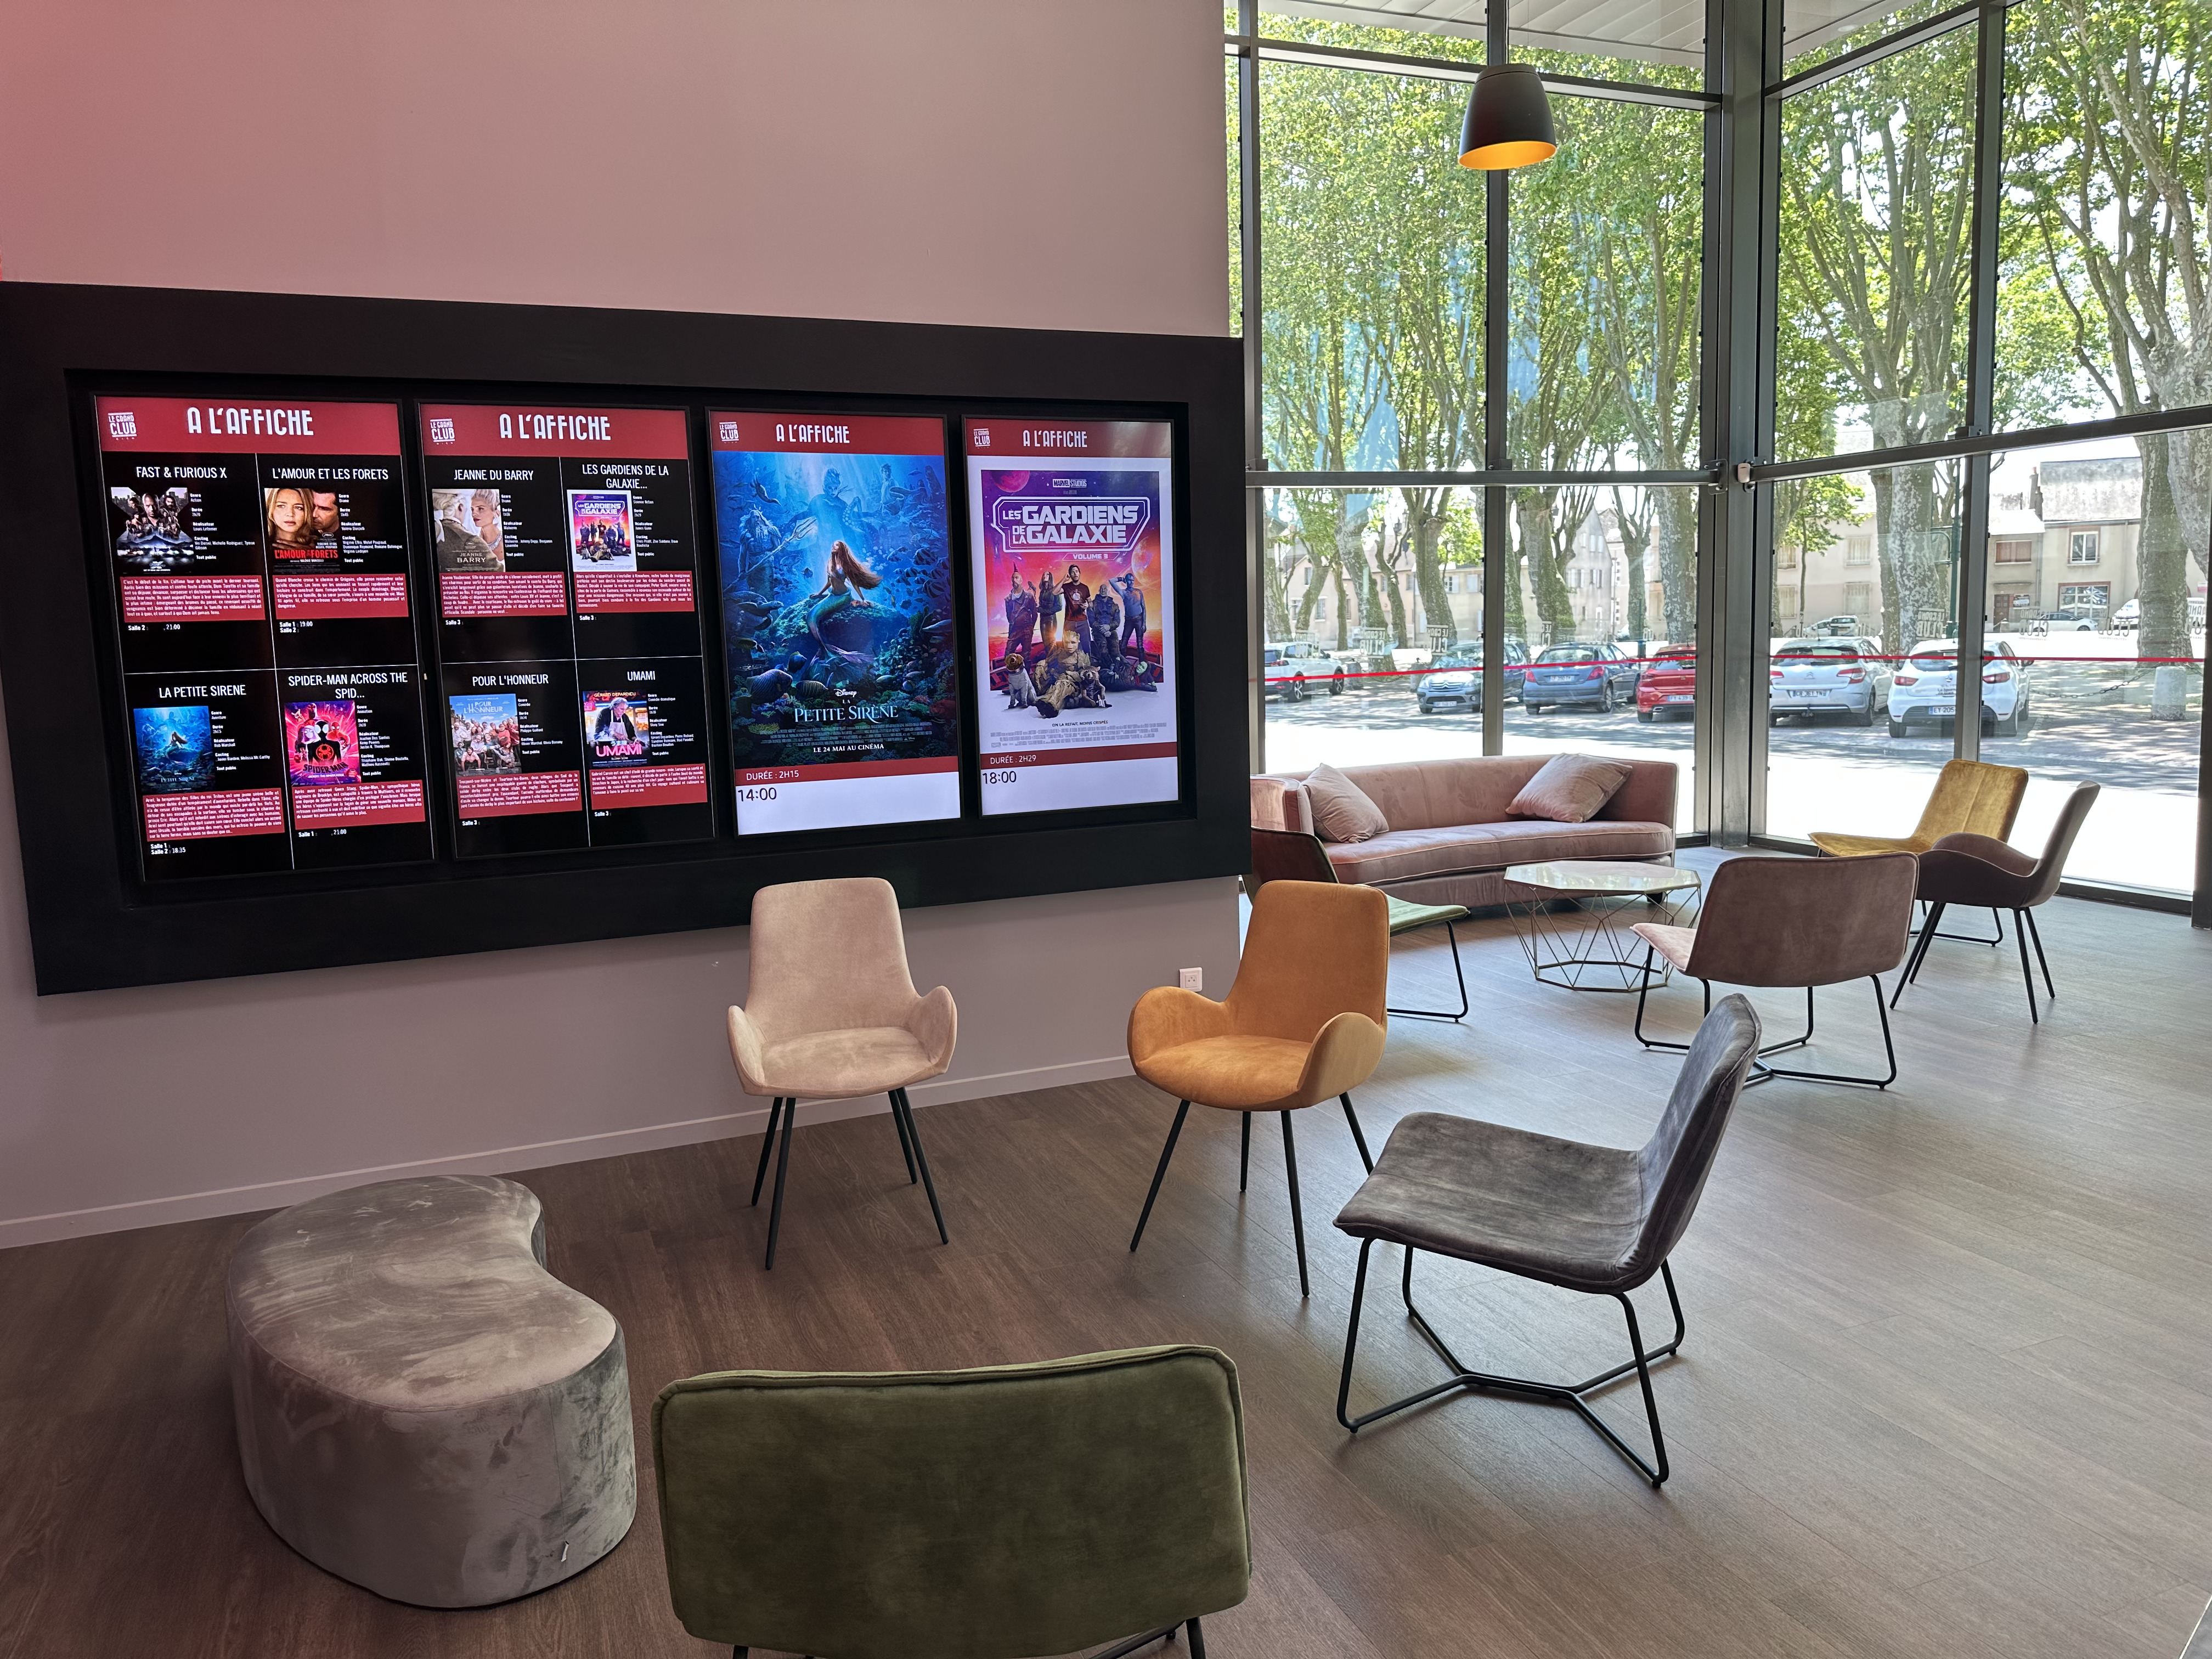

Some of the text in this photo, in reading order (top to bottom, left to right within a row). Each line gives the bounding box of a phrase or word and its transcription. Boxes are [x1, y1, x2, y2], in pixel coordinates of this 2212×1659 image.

[188, 407, 314, 436] A L'AFFICHE
[499, 414, 611, 440] A L'AFFICHE
[110, 422, 136, 435] CLUB
[431, 428, 455, 439] CLUB
[720, 430, 739, 439] CLUB
[776, 424, 850, 443] A L'AFFICHE
[974, 436, 990, 445] CLUB
[1023, 430, 1087, 447] A L'AFFICHE
[137, 467, 227, 478] FAST & FURIOUS X
[273, 468, 388, 479] L'AMOUR ET LES FORETS
[454, 470, 533, 480] JEANNE DU BARRY
[582, 464, 669, 476] LES GARDIENS DE LA
[1053, 479, 1087, 487] MARVEL STUDIOS
[1003, 505, 1139, 524] LES GARDIENS
[1012, 525, 1127, 544] DE GALAXIE
[1012, 535, 1027, 544] LA
[274, 549, 306, 558] L'AMOUR
[311, 549, 338, 558] FORETS
[288, 672, 408, 686] SPIDER-MAN ACROSS THE
[472, 674, 549, 686] POUR L'HONNEUR
[627, 670, 656, 681] UMAMI
[159, 685, 246, 698] LA PETITE SIRENE
[833, 689, 857, 697] Disney
[464, 703, 503, 714] L'HONNEUR
[794, 708, 844, 723] PETITE
[596, 744, 642, 757] UMAMI
[990, 755, 1013, 764] DURÉE
[1019, 754, 1036, 763] 2H29
[302, 761, 349, 774] SPIDER-MAN
[746, 770, 773, 781] DURÉE
[779, 770, 799, 779] 2H15
[982, 771, 1017, 784] 18:00
[738, 787, 777, 802] 14:00
